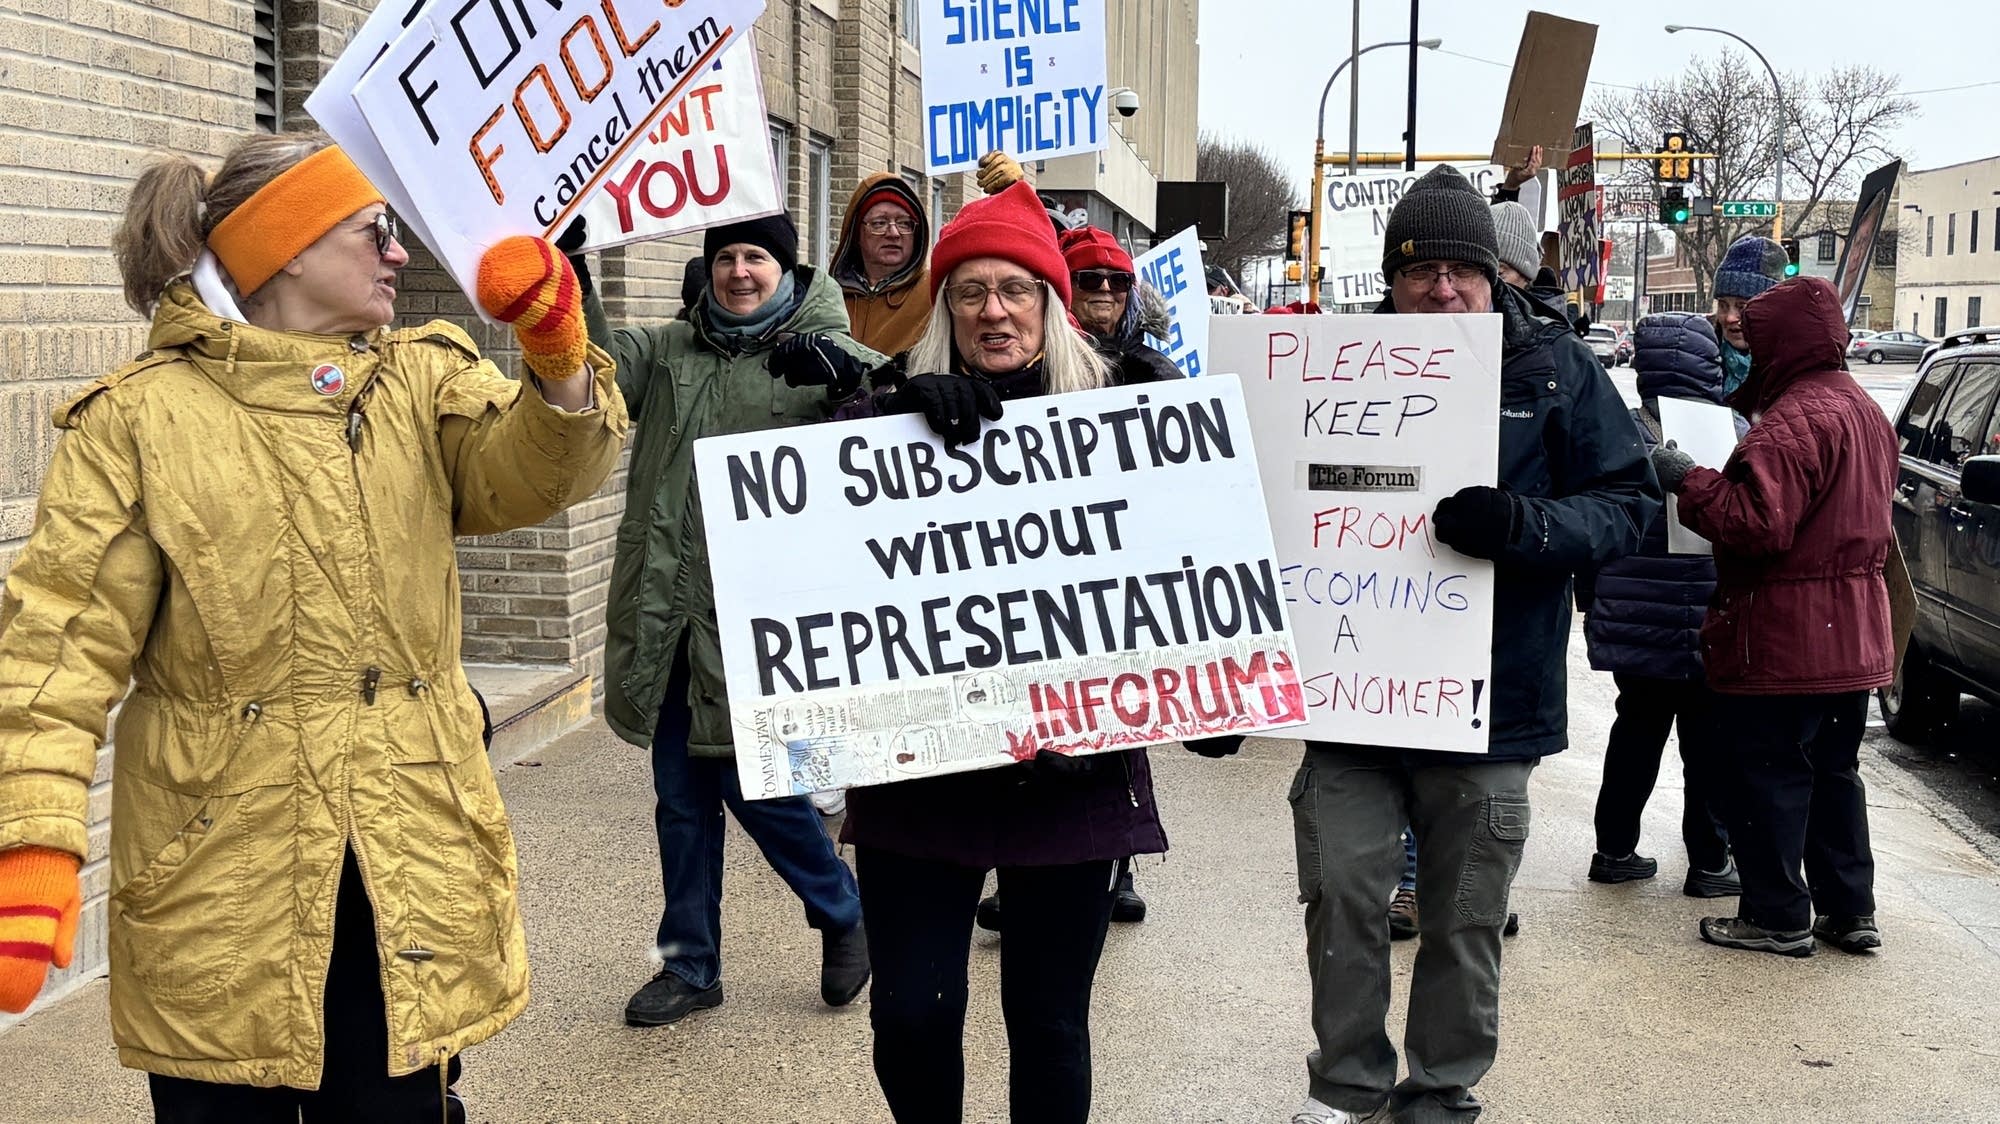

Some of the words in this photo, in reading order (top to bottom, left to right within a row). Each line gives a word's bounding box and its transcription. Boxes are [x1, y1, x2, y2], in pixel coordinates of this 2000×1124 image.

[1004, 45, 1034, 88] IS
[469, 0, 687, 205] FOOL
[533, 92, 632, 227] cancel
[637, 16, 720, 105] them
[648, 84, 723, 145] NT
[603, 144, 731, 234] YOU
[1727, 204, 1736, 214] 4
[1743, 204, 1758, 214] St
[1764, 204, 1773, 214] N
[1141, 247, 1188, 300] NGE
[1267, 332, 1455, 382] PLEASE
[1303, 393, 1438, 438] KEEP
[727, 445, 807, 521] NO
[1312, 467, 1348, 486] The
[1352, 467, 1415, 487] Forum
[1313, 506, 1436, 559] FROM
[1280, 564, 1469, 614] ECOMING
[1333, 613, 1359, 653] A
[1028, 650, 1280, 739] INFORUM
[1302, 671, 1485, 730] SNOMER!
